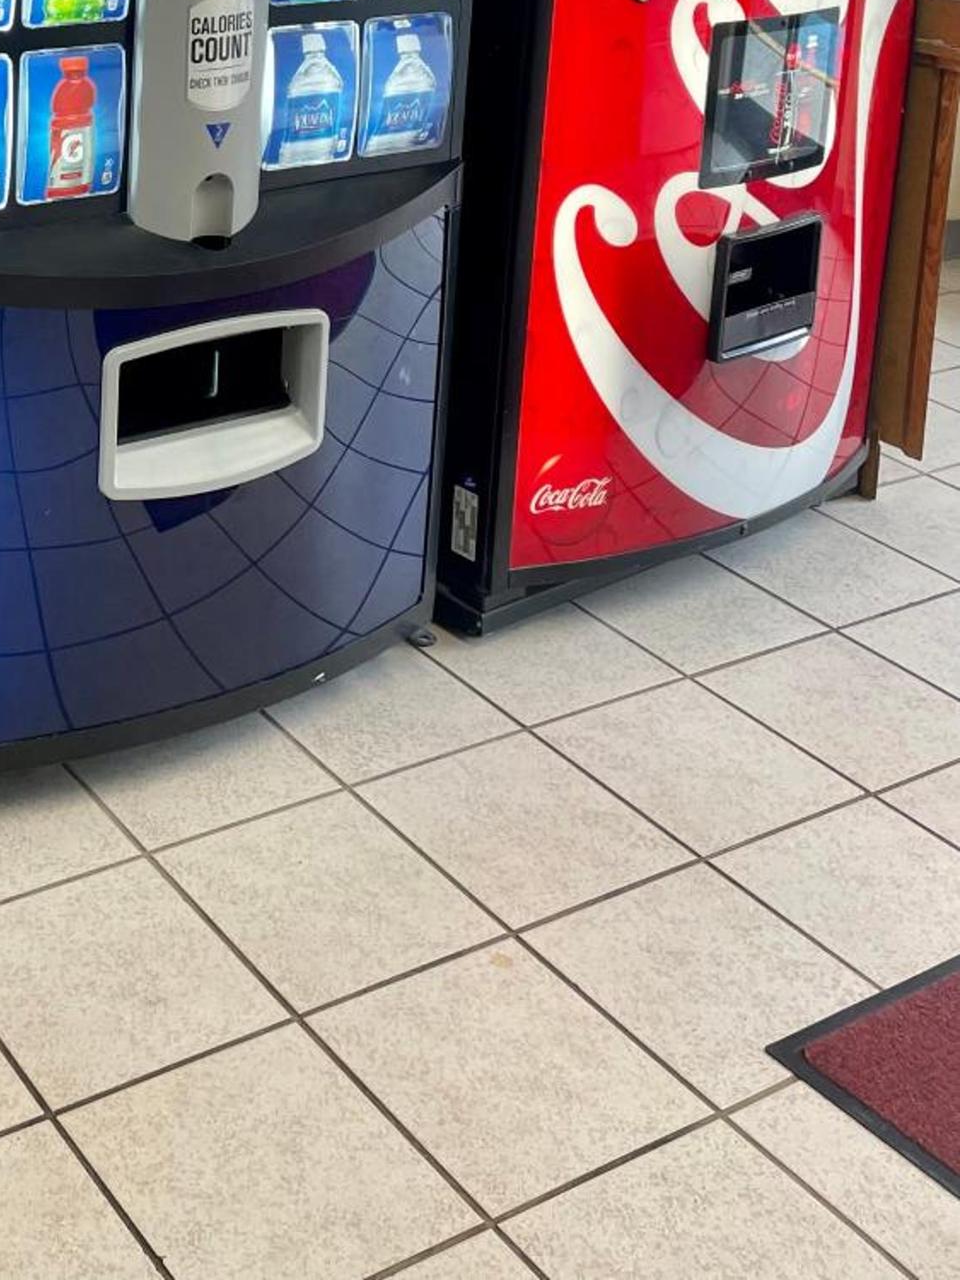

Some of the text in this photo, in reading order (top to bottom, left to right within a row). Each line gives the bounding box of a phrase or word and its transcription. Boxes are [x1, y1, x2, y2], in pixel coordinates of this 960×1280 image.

[191, 11, 253, 36] CALORIES
[191, 31, 253, 64] COUNT
[529, 476, 614, 516] Coca-Cola
